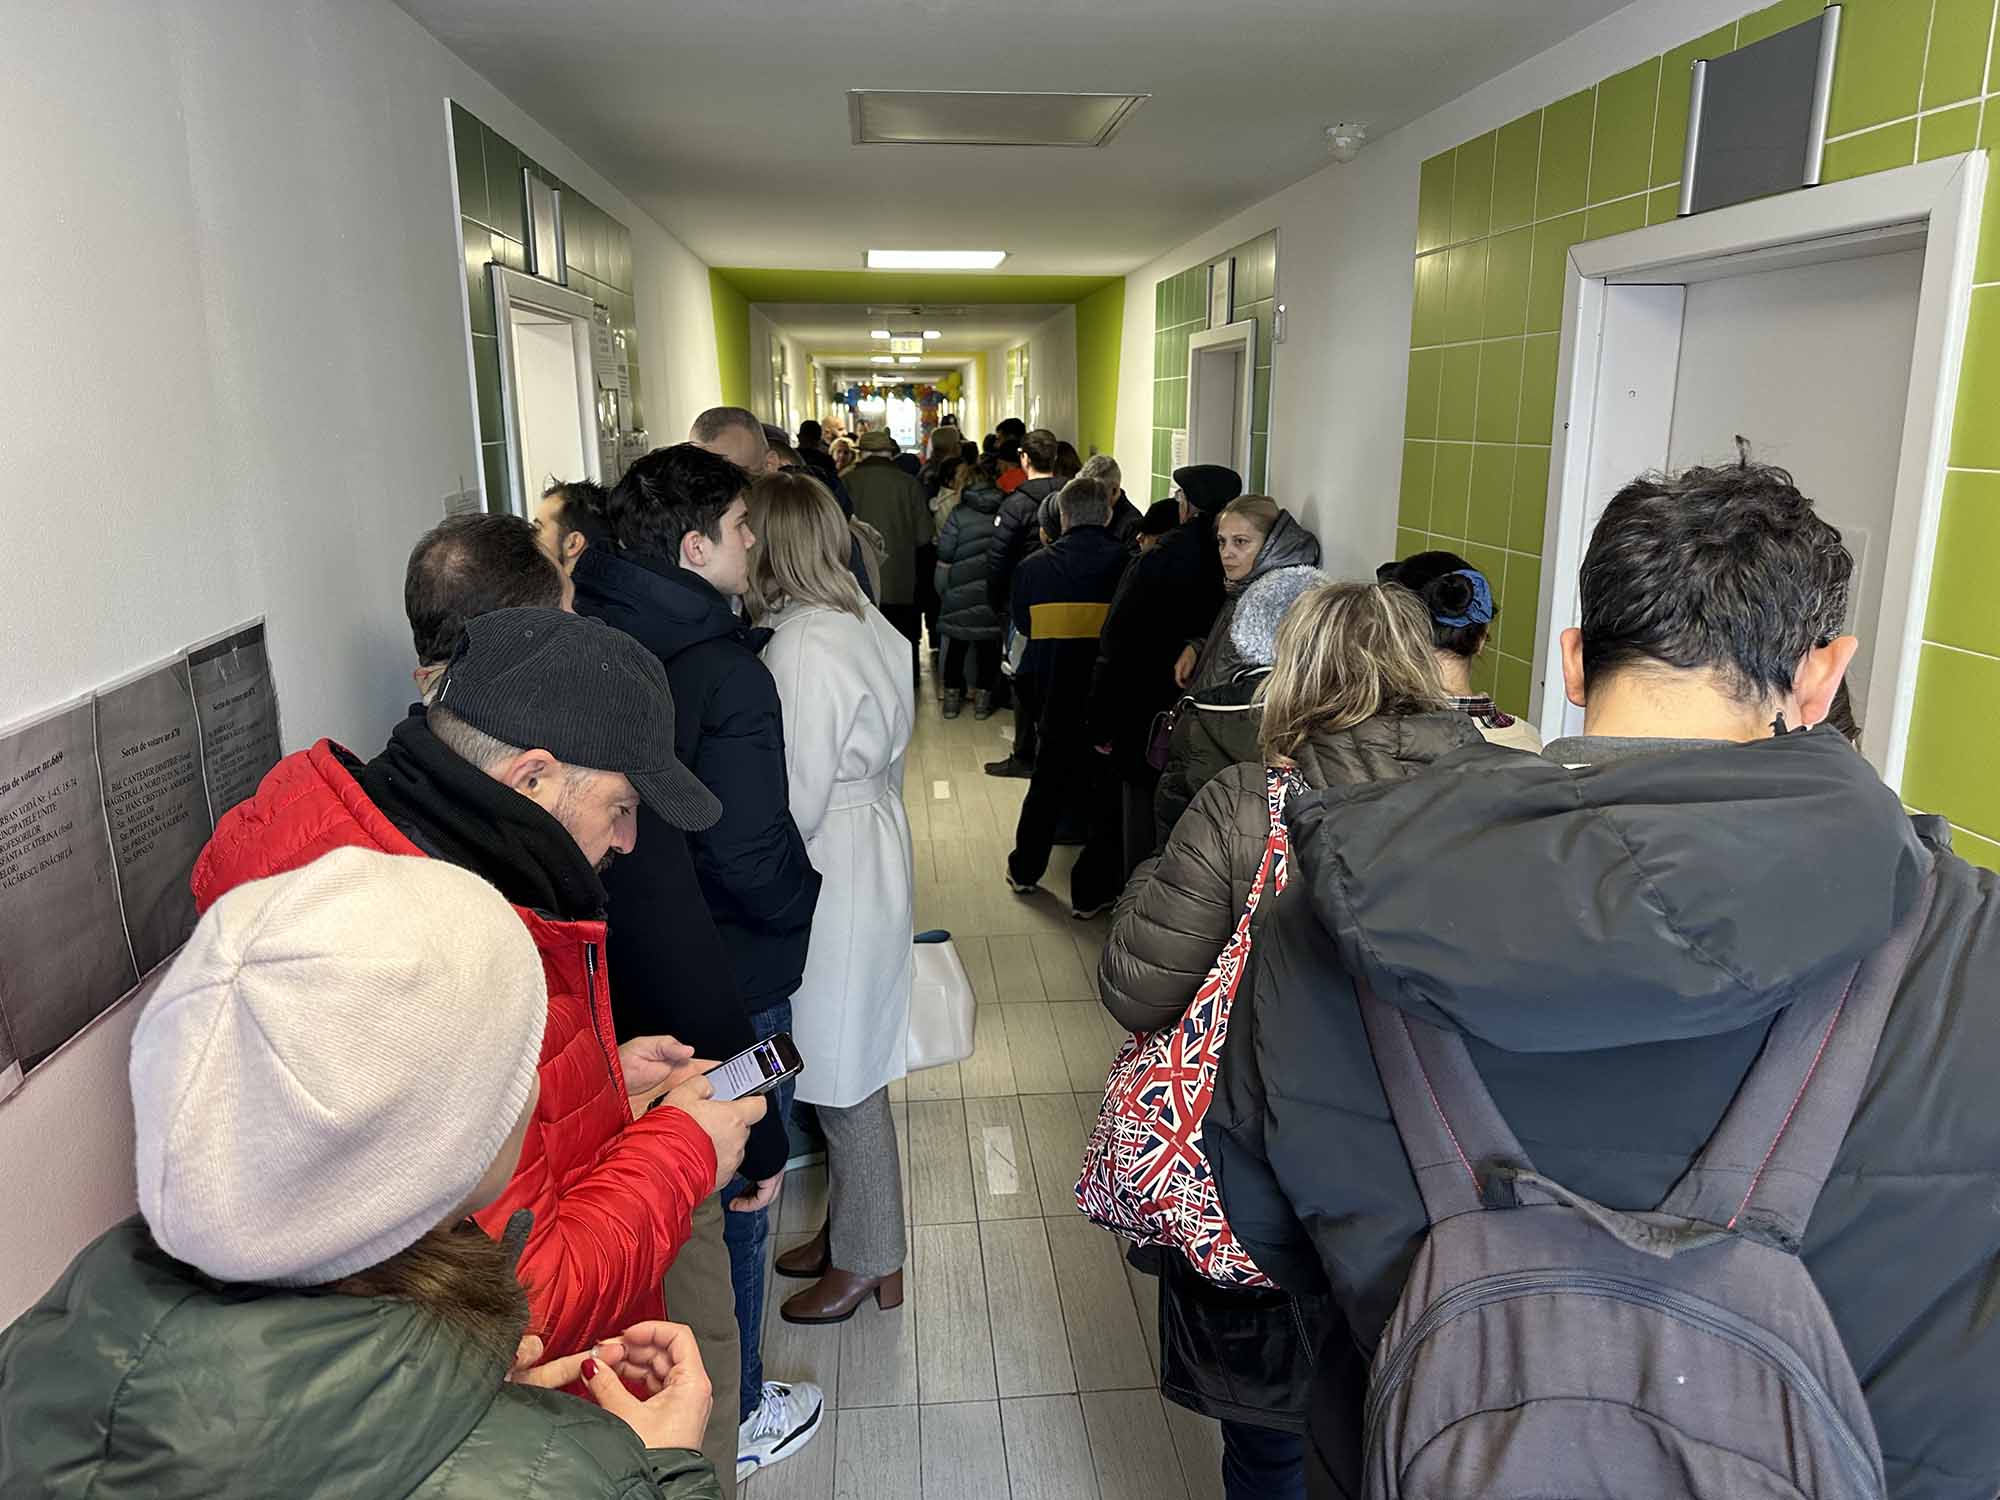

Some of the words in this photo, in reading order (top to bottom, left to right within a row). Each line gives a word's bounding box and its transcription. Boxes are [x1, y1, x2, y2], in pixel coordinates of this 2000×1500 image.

[12, 776, 21, 789] de
[20, 766, 41, 783] votare
[0, 863, 19, 880] ELOR)
